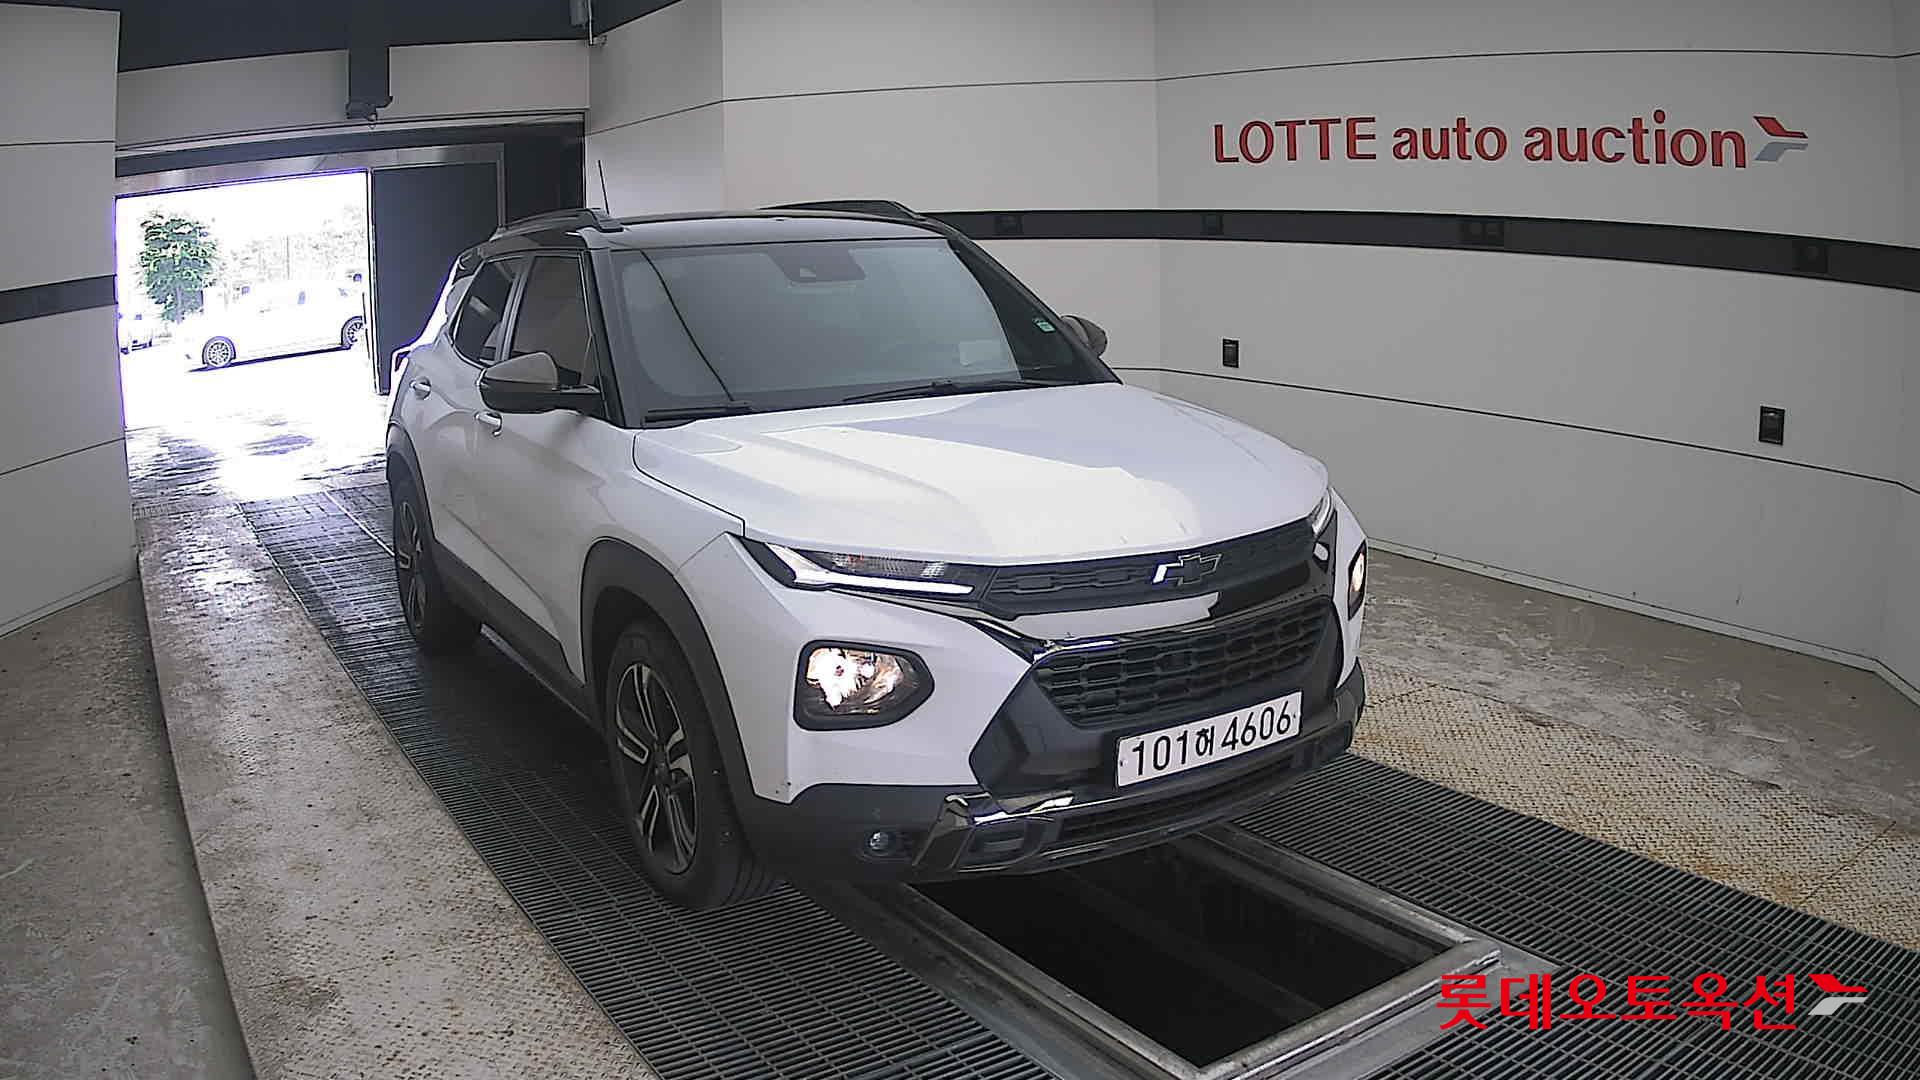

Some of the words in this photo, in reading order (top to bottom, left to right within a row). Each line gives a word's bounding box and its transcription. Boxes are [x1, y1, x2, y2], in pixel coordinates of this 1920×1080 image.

[1214, 117, 1376, 164] LOTTE
[1392, 117, 1507, 161] auto
[1524, 110, 1747, 168] auction
